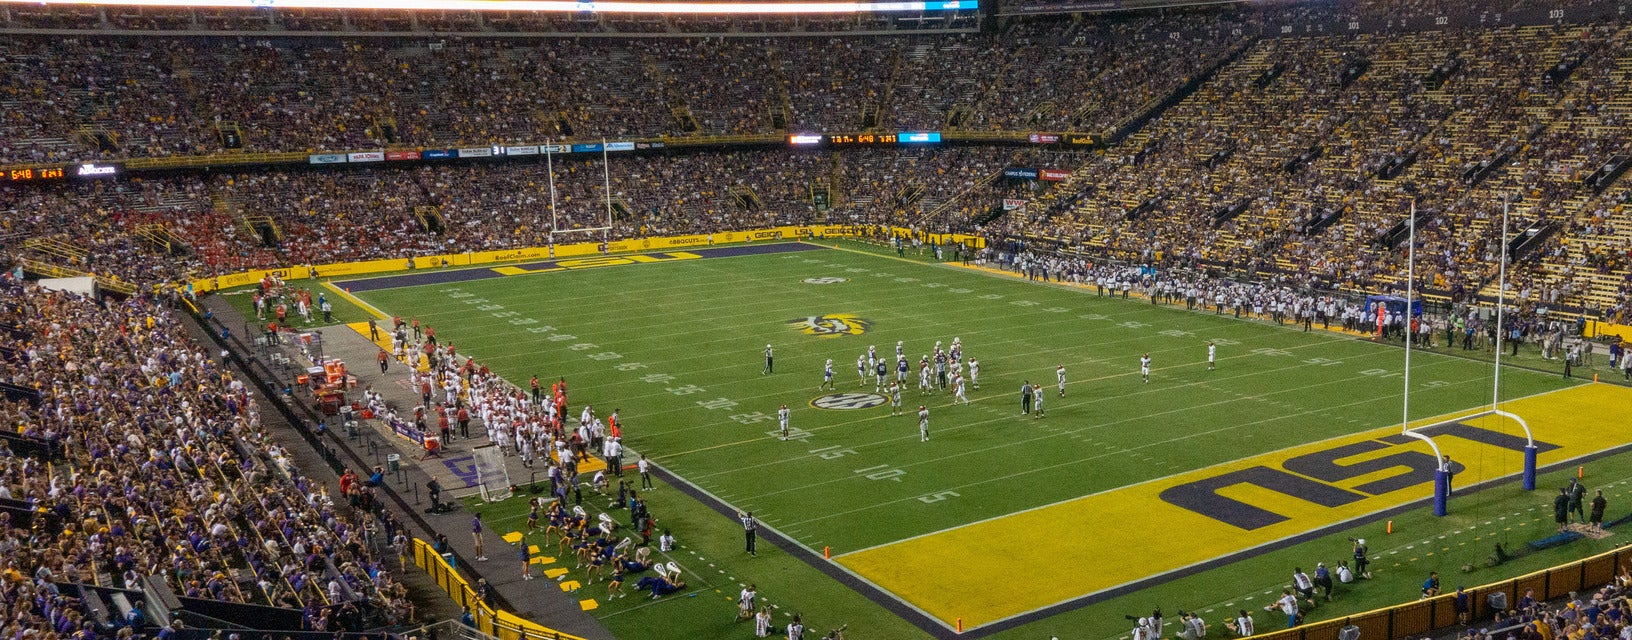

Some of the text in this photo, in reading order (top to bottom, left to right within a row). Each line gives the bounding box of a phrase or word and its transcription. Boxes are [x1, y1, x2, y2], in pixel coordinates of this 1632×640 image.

[1550, 10, 1564, 18] 103
[1435, 17, 1448, 25] 102
[1348, 22, 1360, 30] 101
[858, 135, 875, 143] 6:48
[11, 169, 33, 180] 6:48
[754, 230, 783, 238] GEICO
[808, 444, 859, 460] 15
[852, 463, 907, 481] 10
[1160, 421, 1563, 531] LSU
[917, 490, 961, 504] 5
